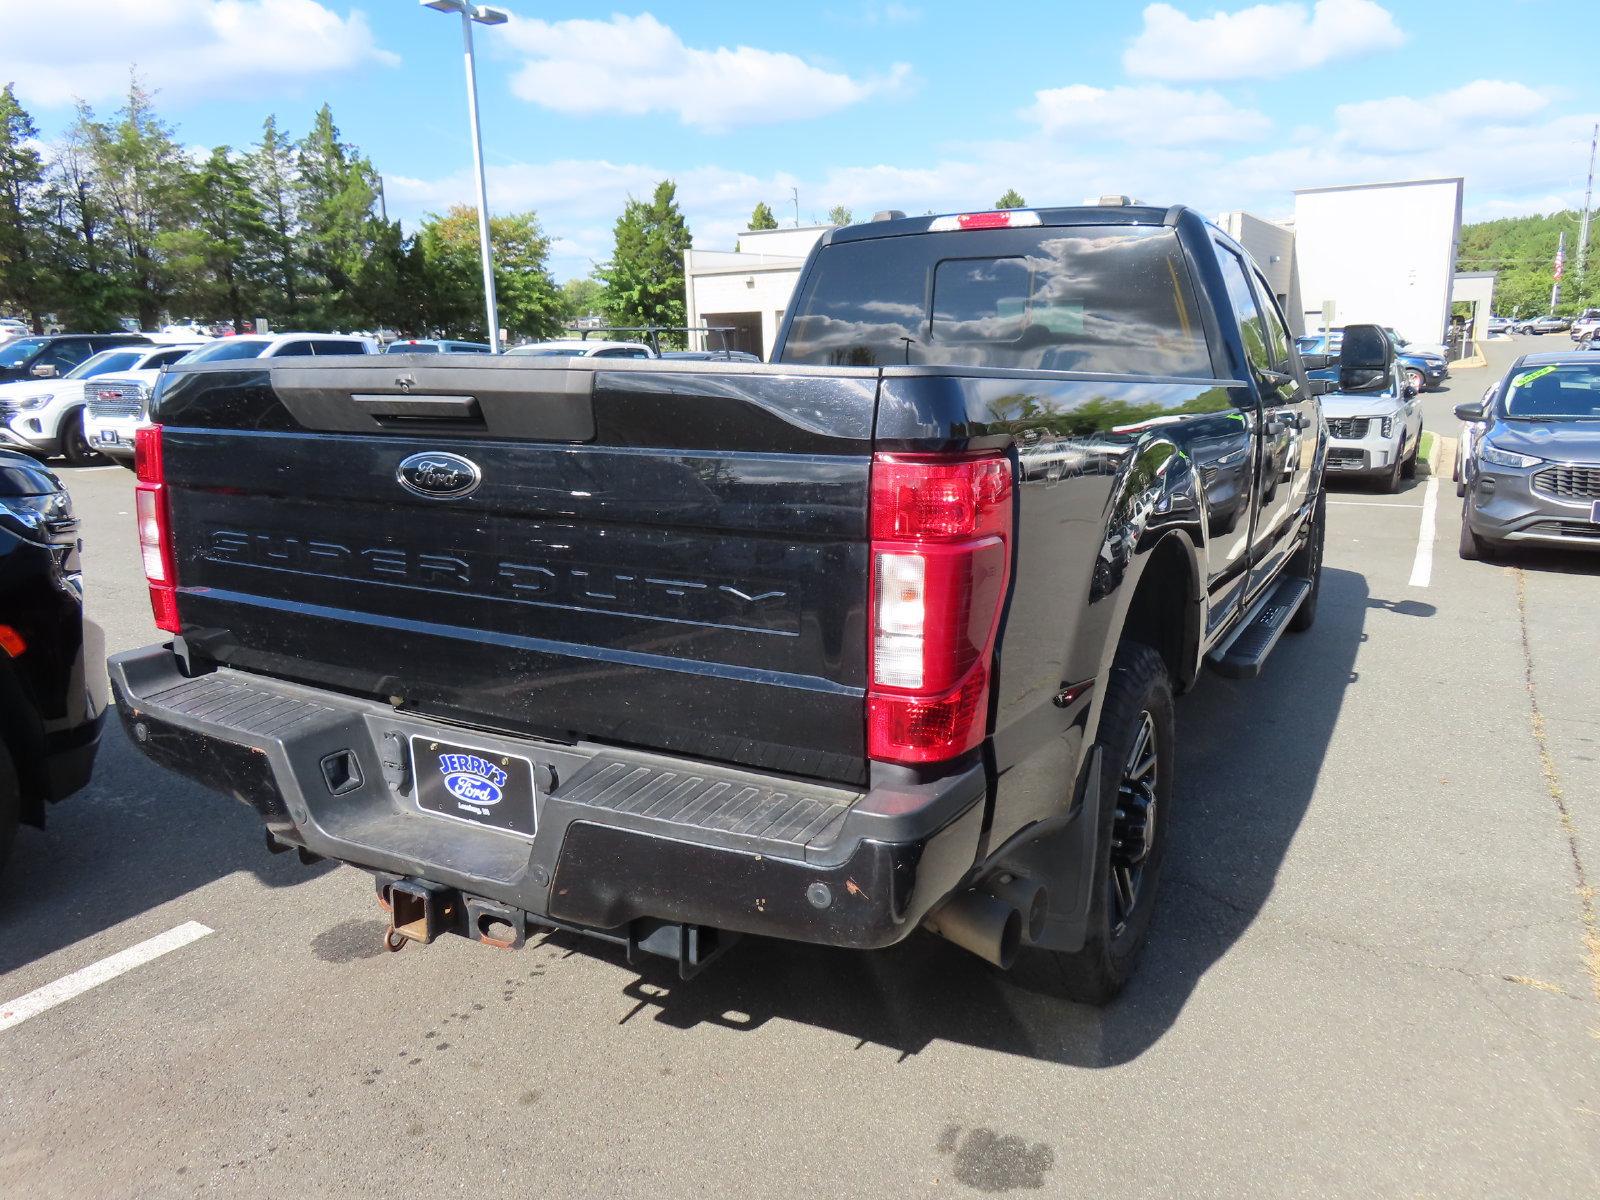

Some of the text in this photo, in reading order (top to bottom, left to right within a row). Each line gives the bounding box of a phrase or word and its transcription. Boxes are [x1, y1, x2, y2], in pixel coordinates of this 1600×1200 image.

[413, 460, 459, 487] Ford
[210, 530, 788, 617] SUPER DUTY
[439, 754, 507, 787] JERRY'S
[454, 777, 490, 800] Ford
